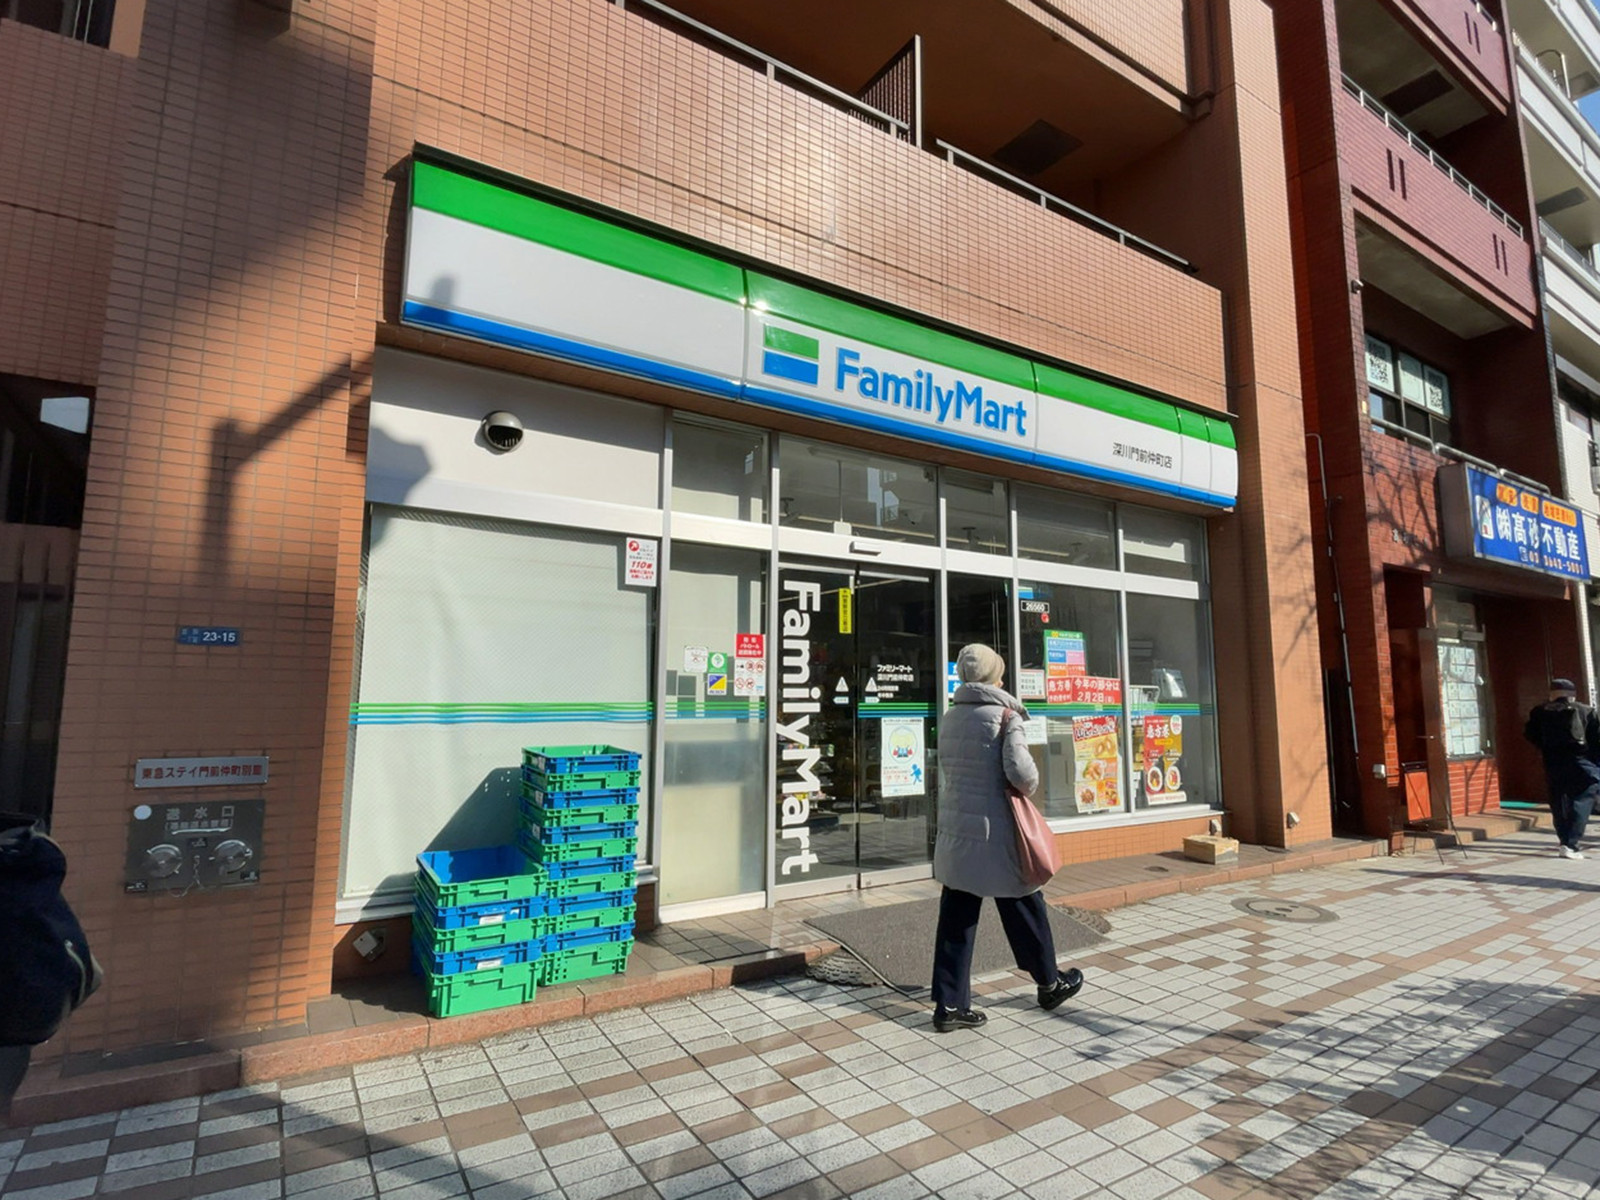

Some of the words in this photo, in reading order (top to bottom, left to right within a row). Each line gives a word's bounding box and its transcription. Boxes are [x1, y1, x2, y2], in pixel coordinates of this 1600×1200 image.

[836, 347, 1027, 436] FamilyMart
[1112, 442, 1173, 469] 深川門前仲町店
[203, 631, 236, 642] 23-15
[877, 664, 913, 673] ファミリーマート
[1074, 677, 1120, 692] 今年の節分は
[776, 580, 821, 875] FamilyMart
